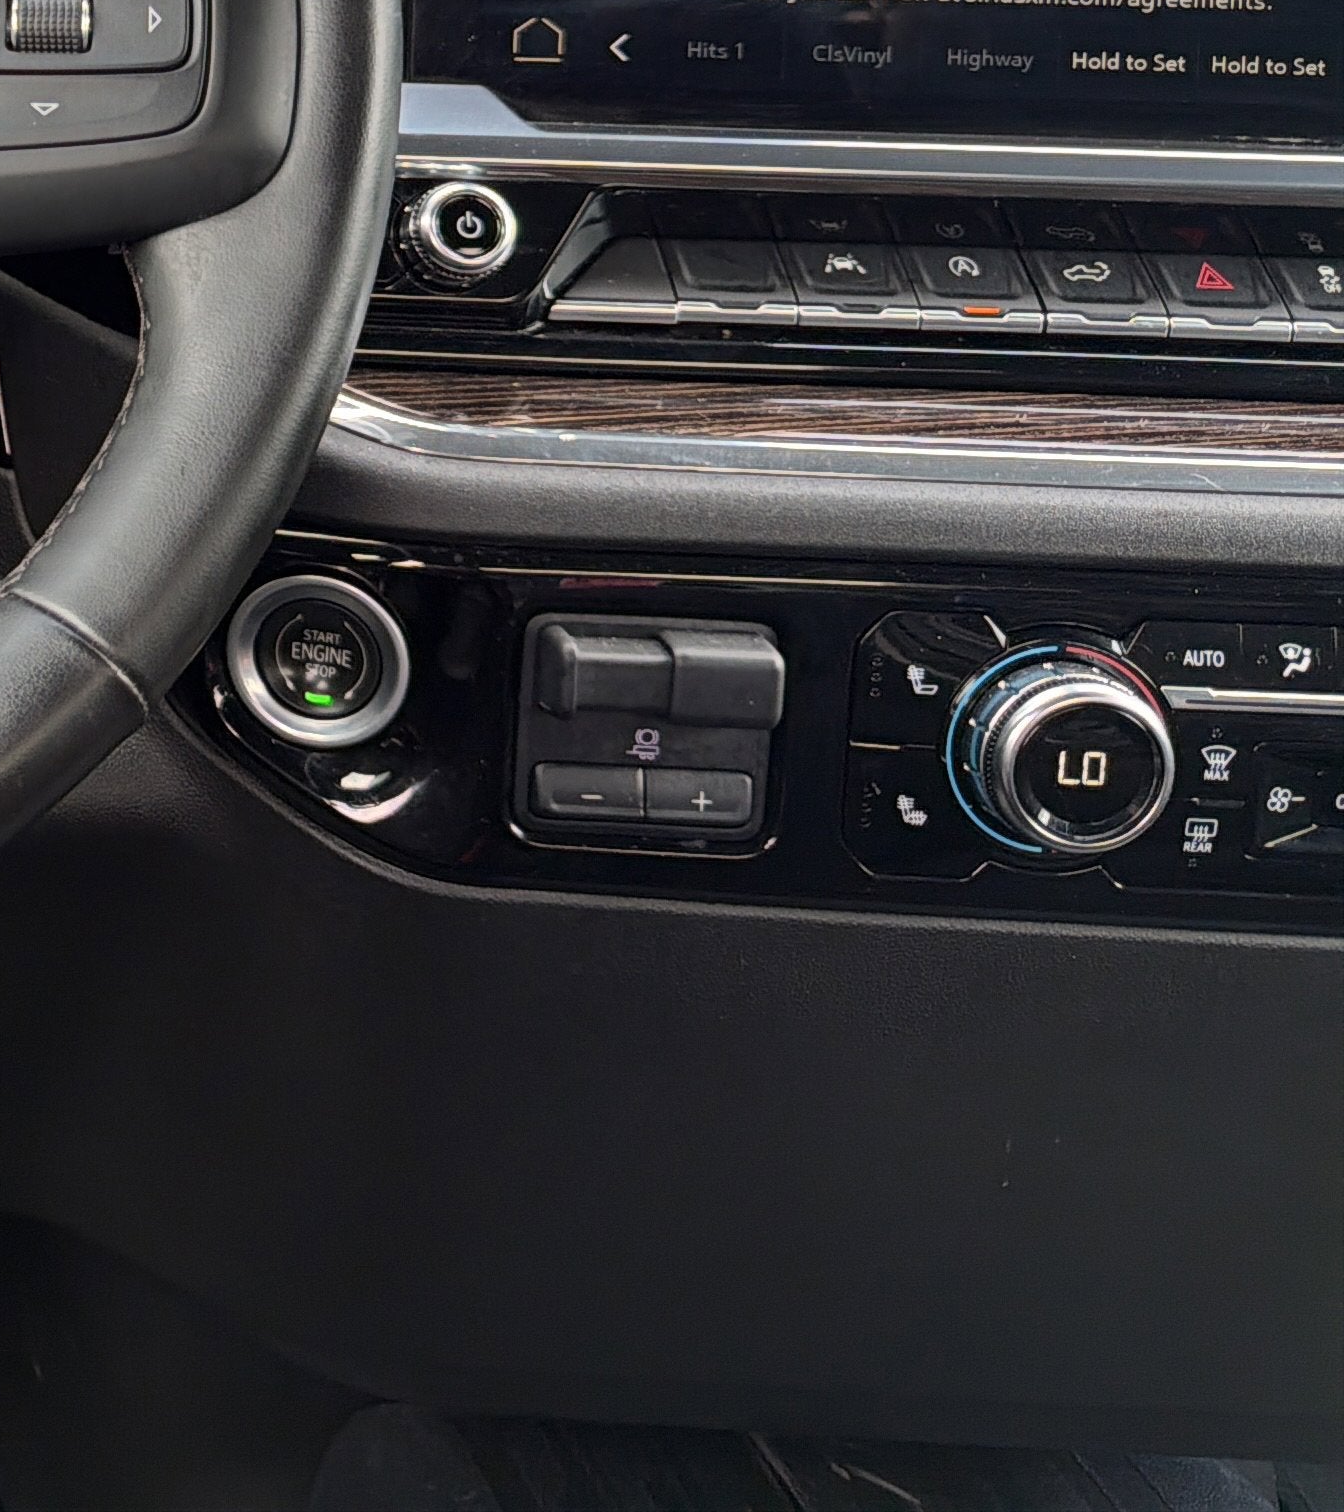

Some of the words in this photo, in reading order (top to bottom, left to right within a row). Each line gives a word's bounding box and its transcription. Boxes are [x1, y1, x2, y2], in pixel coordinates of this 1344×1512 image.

[686, 40, 727, 59] Hits
[733, 41, 743, 59] 1
[812, 44, 892, 67] ClsVinyl
[947, 47, 1034, 72] Highway
[1071, 51, 1120, 71] Hold
[1125, 54, 1147, 72] to
[1152, 53, 1186, 73] Set
[1210, 55, 1260, 75] Hold
[1265, 58, 1287, 76] to
[1292, 57, 1326, 77] Set
[303, 628, 341, 645] START
[291, 641, 352, 668] ENGINE
[1182, 649, 1225, 667] AUTO
[304, 662, 336, 678] STOP
[1057, 750, 1106, 786] LO
[1203, 769, 1230, 781] MAX
[1182, 841, 1212, 853] REAR
